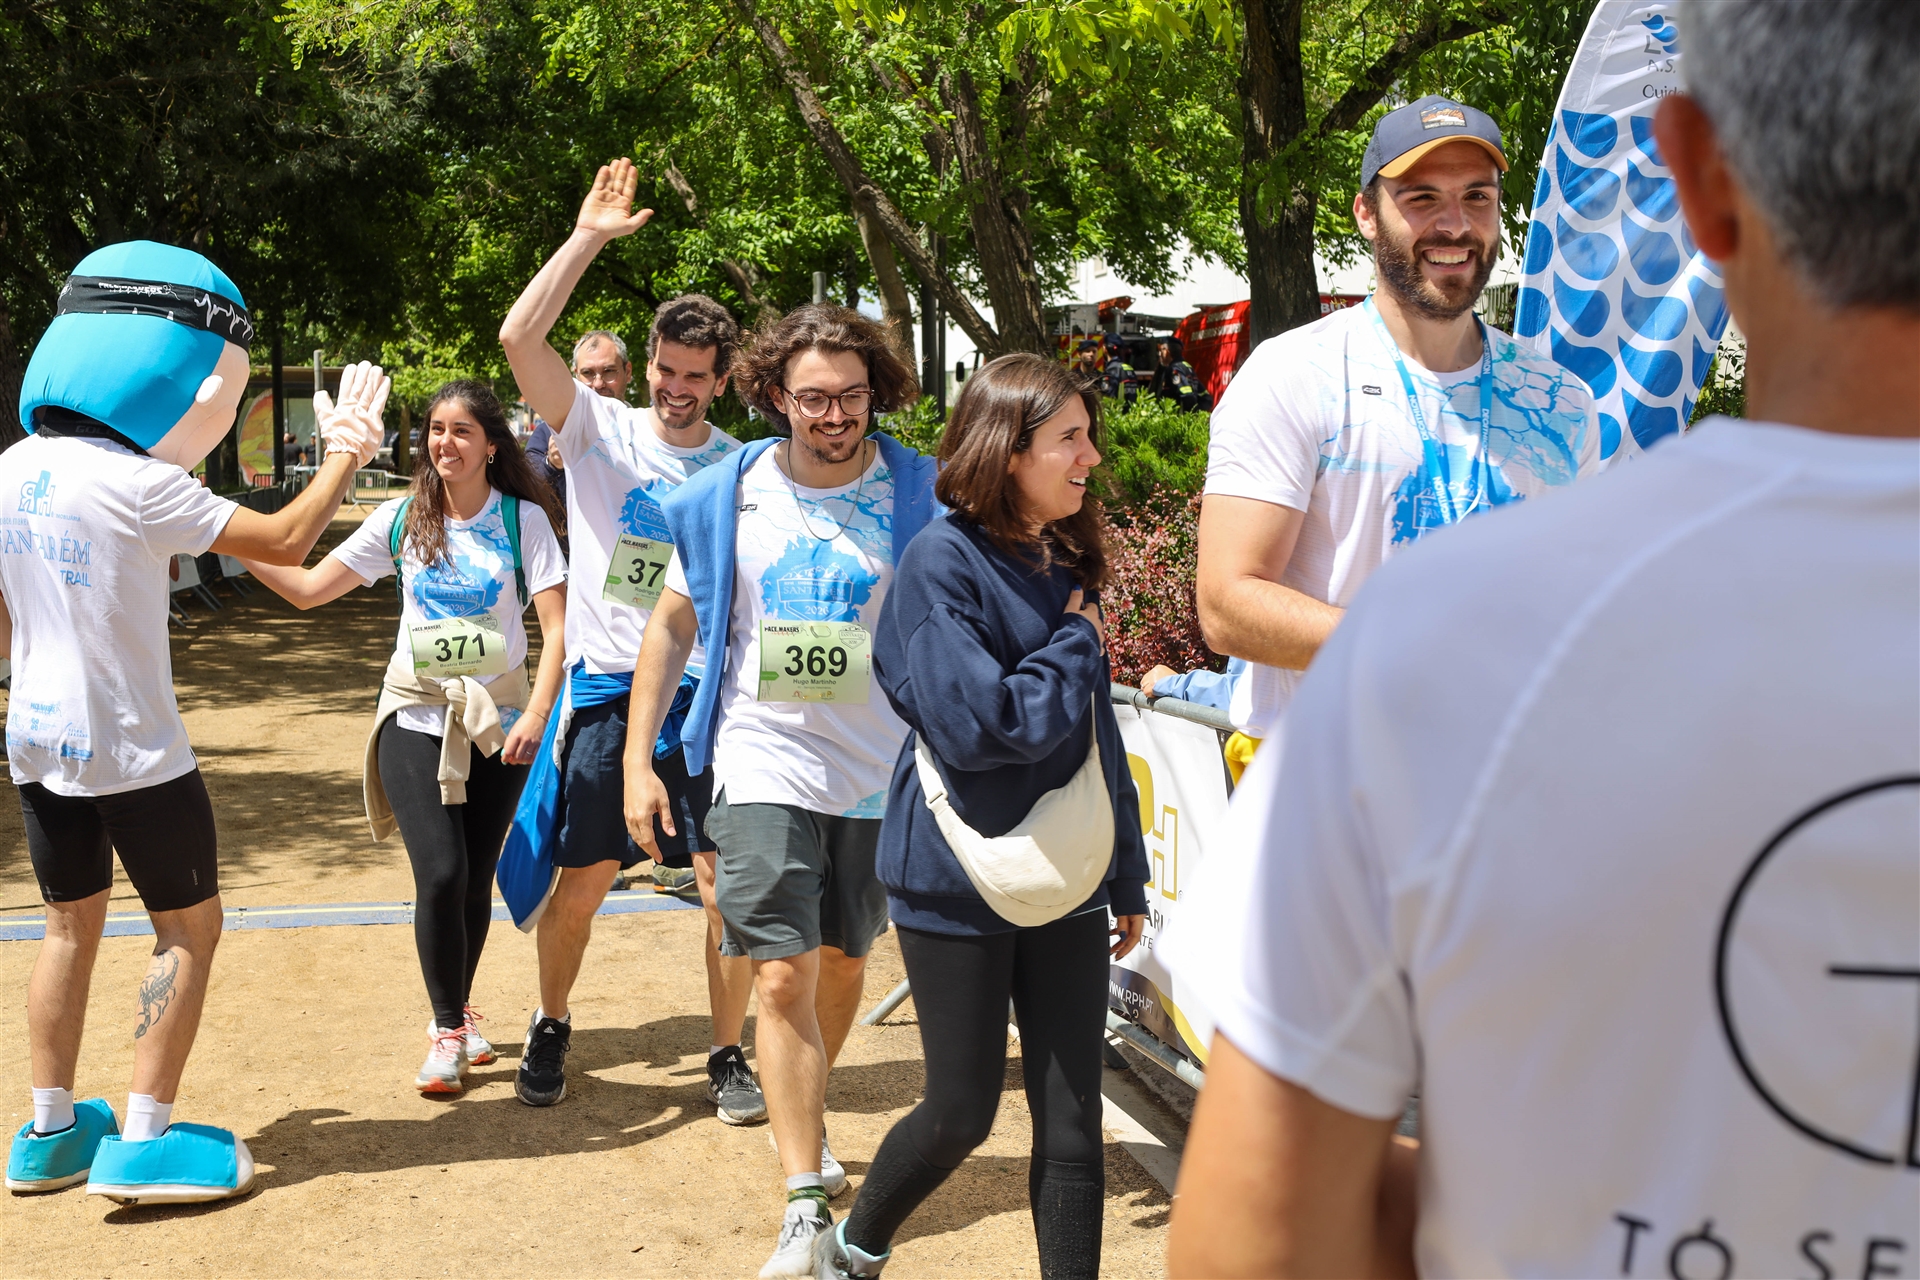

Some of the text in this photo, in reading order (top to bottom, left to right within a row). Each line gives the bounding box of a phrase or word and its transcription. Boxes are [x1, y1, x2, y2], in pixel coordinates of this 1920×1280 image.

[0, 529, 92, 566] ANTARÉM
[60, 569, 92, 588] TRAIL
[627, 558, 665, 590] 37
[804, 605, 830, 616] 2026
[434, 633, 485, 662] 371
[784, 645, 848, 677] 369
[1108, 979, 1154, 1014] WW.RPH.PT
